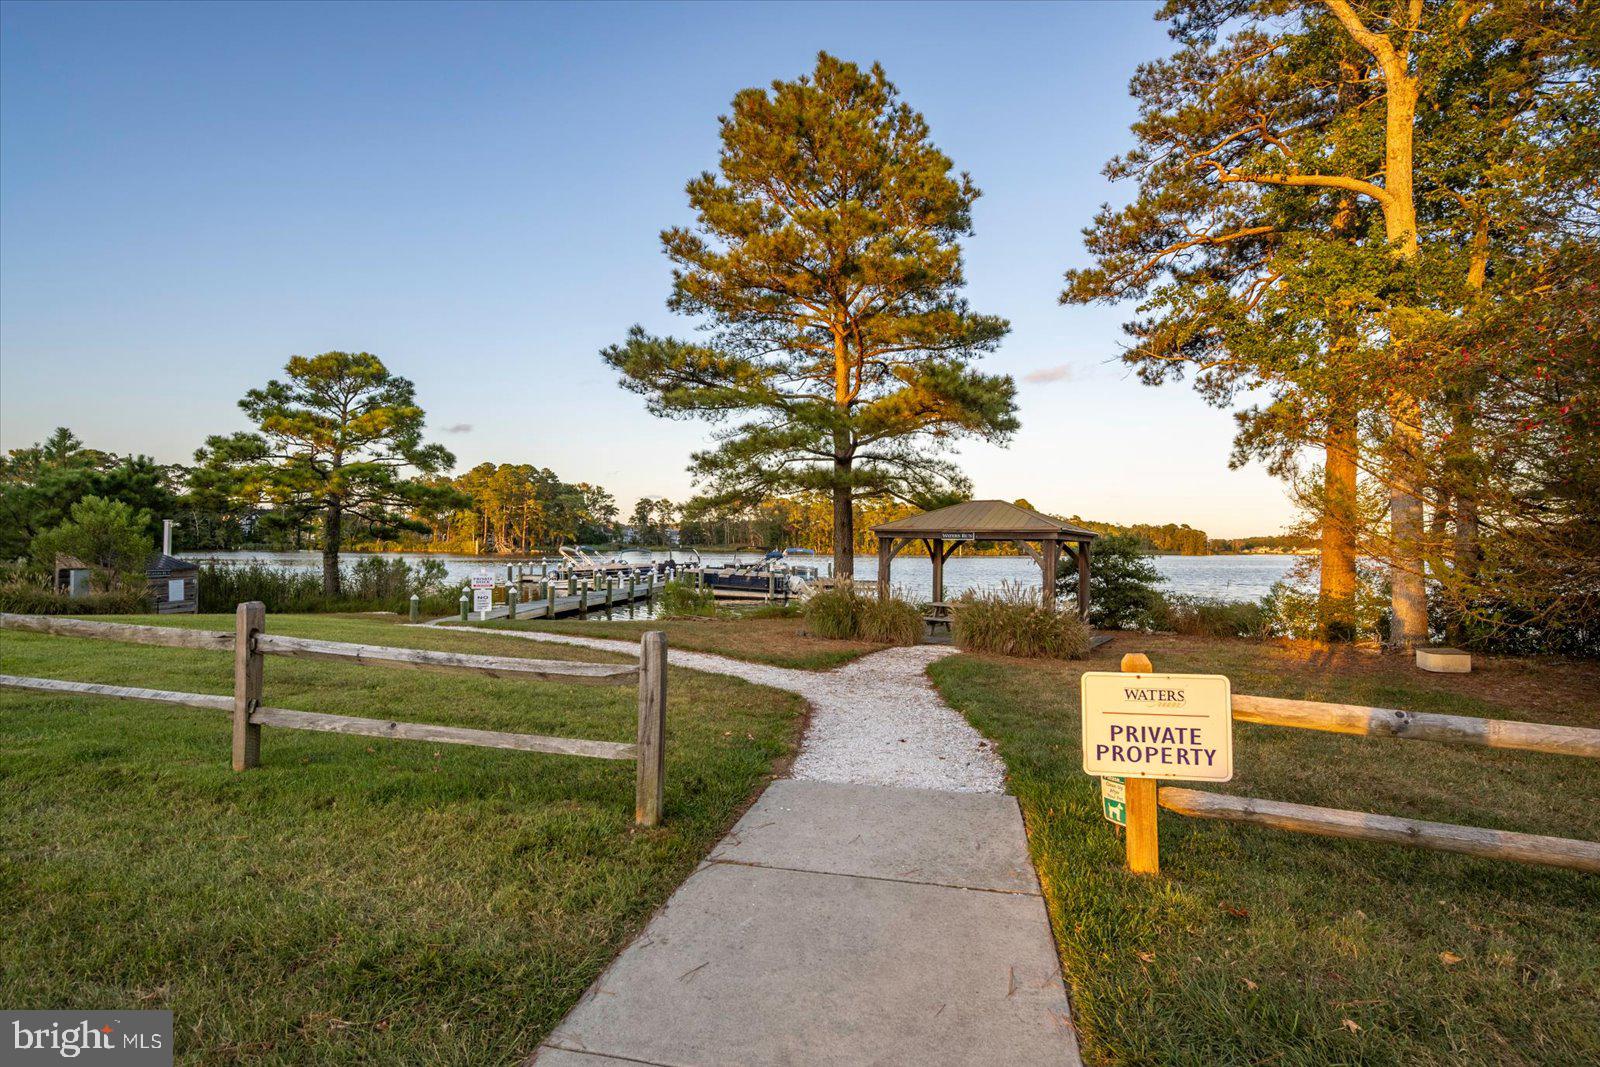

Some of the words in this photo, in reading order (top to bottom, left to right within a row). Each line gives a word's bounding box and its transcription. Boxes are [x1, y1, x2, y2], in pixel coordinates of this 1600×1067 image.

[1124, 688, 1185, 702] WATERS
[1110, 725, 1202, 745] PRIVATE
[1096, 744, 1216, 766] PROPERTY
